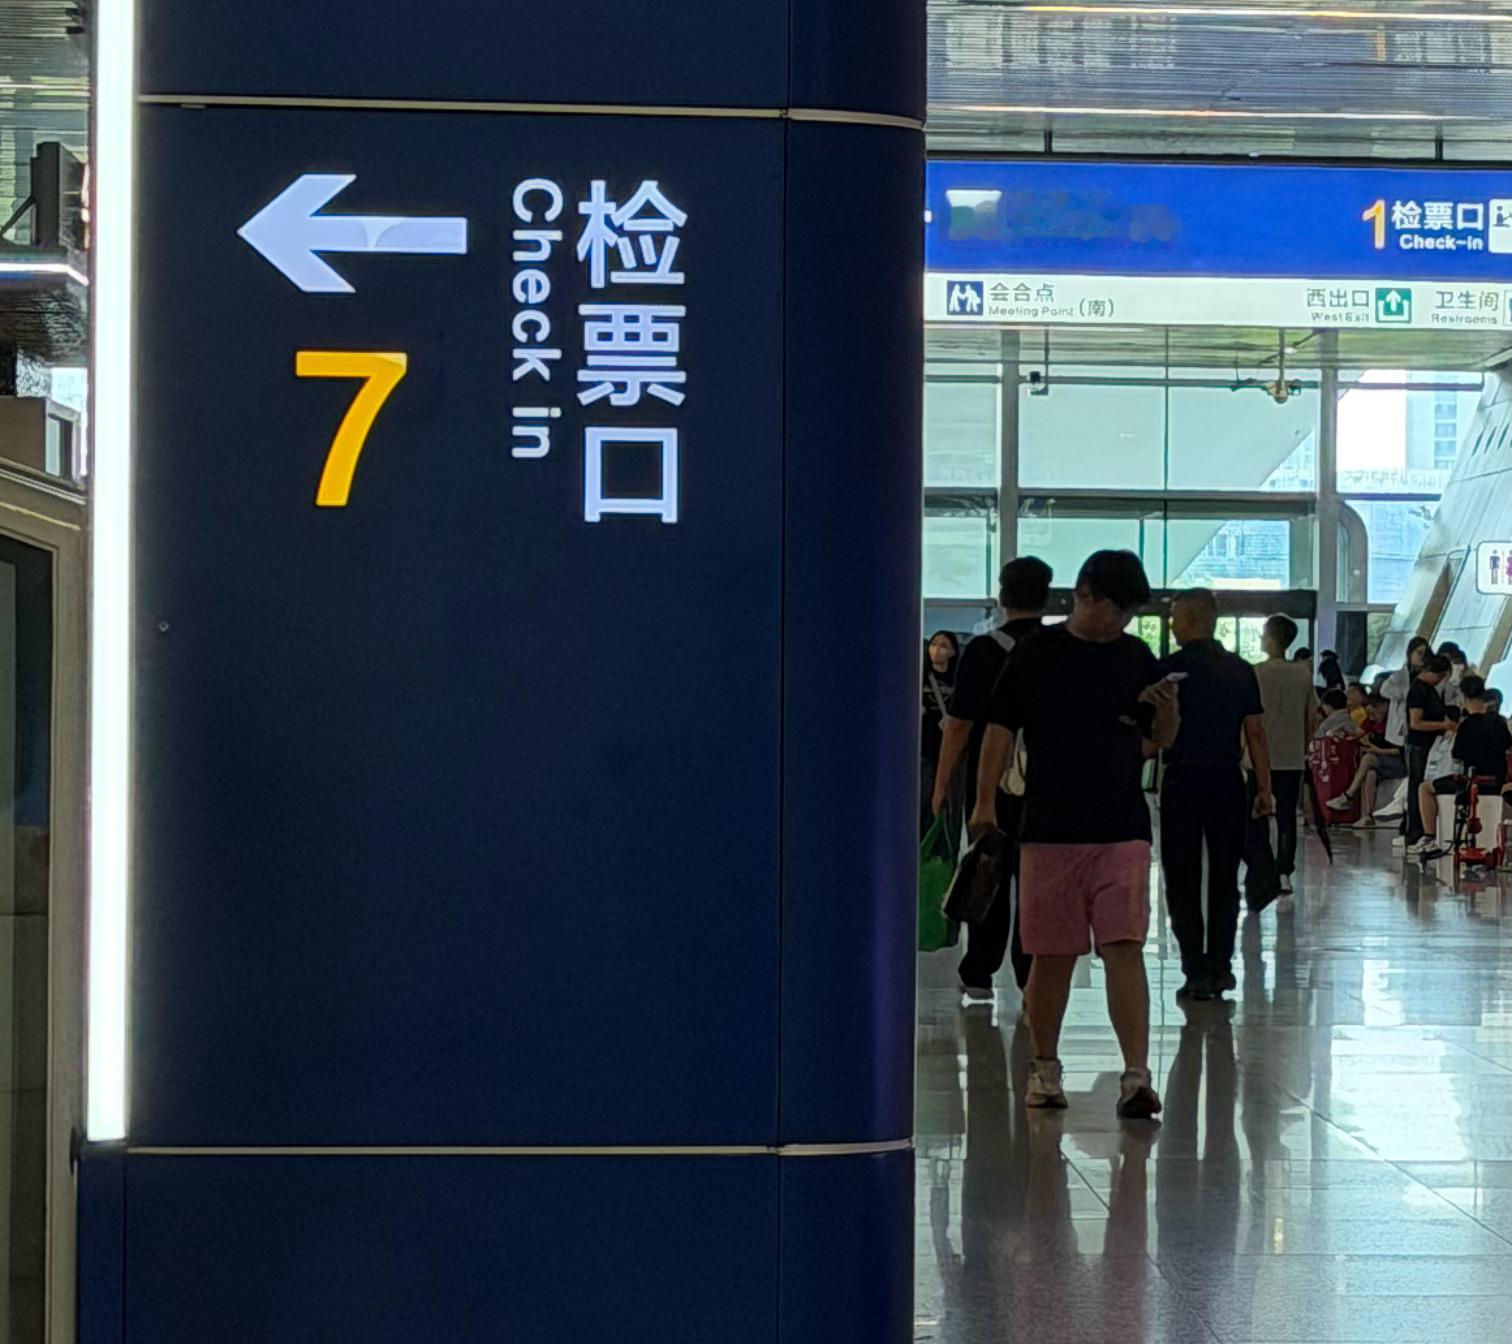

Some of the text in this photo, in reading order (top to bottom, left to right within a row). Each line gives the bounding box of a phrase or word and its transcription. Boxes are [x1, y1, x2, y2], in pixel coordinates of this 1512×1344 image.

[1362, 199, 1484, 249] 1 检票口
[1399, 234, 1484, 250] Check-in
[989, 282, 1055, 302] 会合点
[1306, 288, 1369, 308] 西出口
[1435, 290, 1499, 311] 卫生间
[512, 179, 563, 458] Check in
[988, 306, 1074, 317] Meeting Point
[577, 180, 687, 523] 检票口
[295, 350, 407, 506] 7
